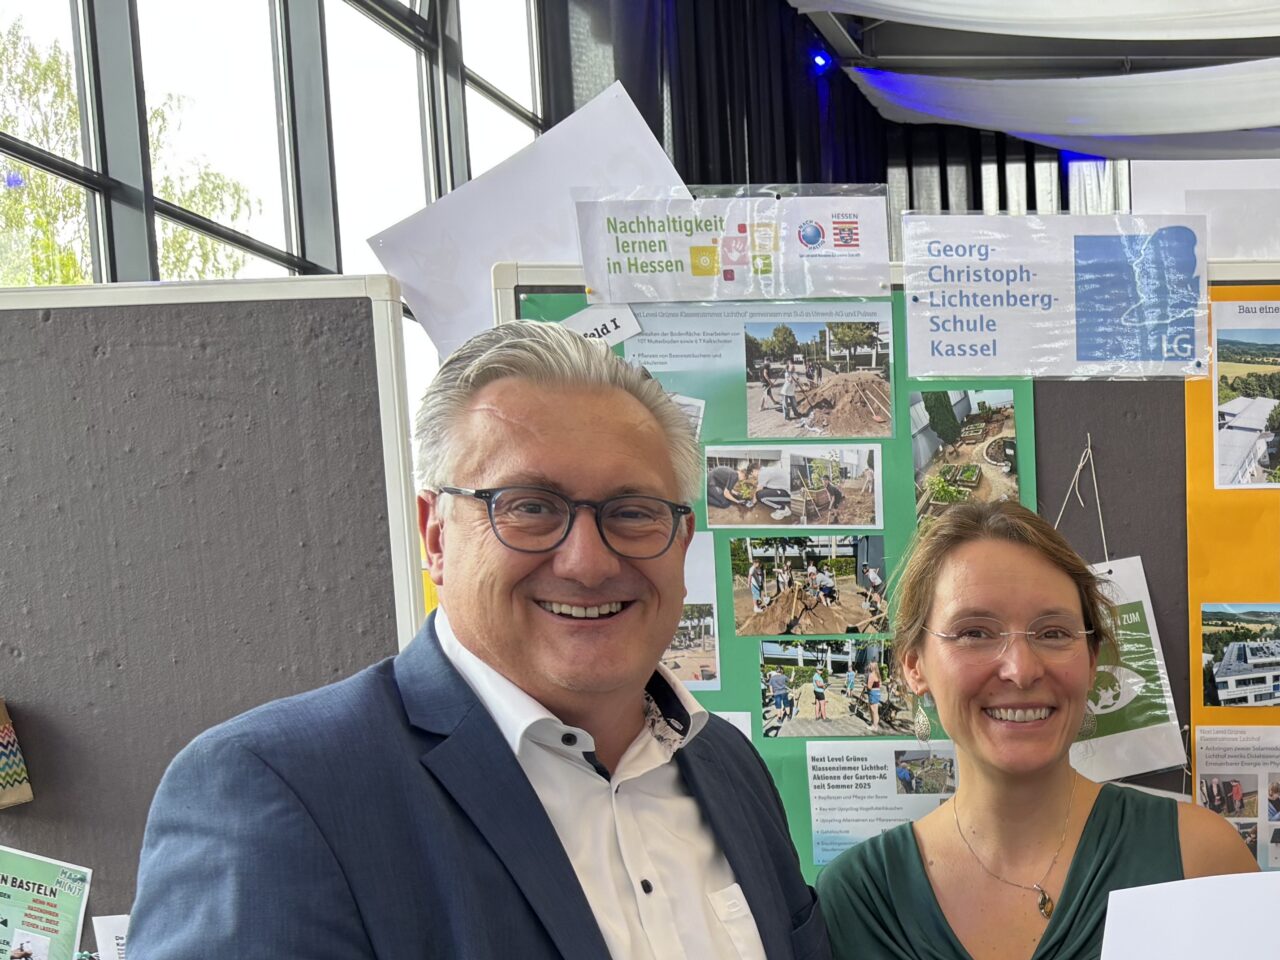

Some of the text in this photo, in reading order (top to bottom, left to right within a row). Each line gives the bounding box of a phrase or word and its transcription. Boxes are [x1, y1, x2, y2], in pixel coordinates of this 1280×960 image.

[606, 215, 725, 237] Nachhaltigkeit
[615, 236, 667, 253] lernen
[927, 240, 997, 261] Georg-
[607, 257, 684, 274] in Hessen
[928, 265, 1037, 285] Christoph-
[929, 290, 1059, 310] Lichtenberg-
[1237, 304, 1257, 314] Bau
[930, 315, 997, 332] Schule
[930, 339, 997, 357] Kassel
[1162, 335, 1192, 357] LG
[1122, 611, 1141, 625] ZUM
[11, 877, 58, 899] BASTELN
